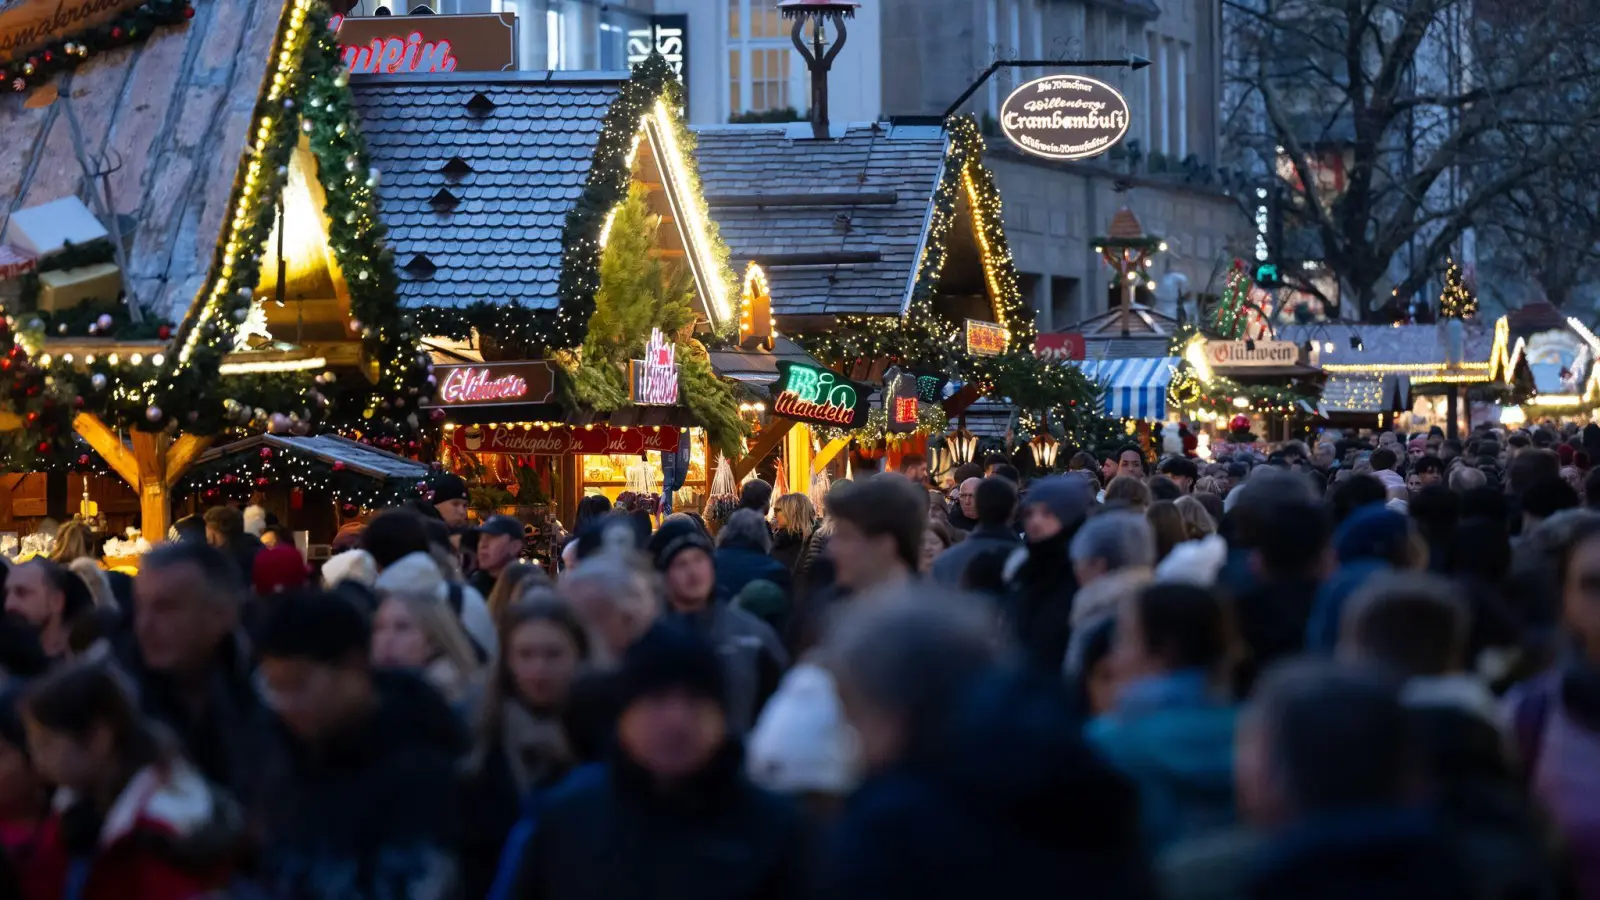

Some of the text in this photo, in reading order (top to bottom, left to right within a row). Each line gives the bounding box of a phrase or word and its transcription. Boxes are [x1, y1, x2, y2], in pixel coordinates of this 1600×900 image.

[329, 14, 457, 73] wein
[1005, 110, 1124, 129] Crambambuli
[1024, 97, 1106, 112] Willenborgs
[786, 365, 857, 409] Bio
[775, 390, 855, 424] Mandeln
[491, 426, 563, 454] Rückgabe
